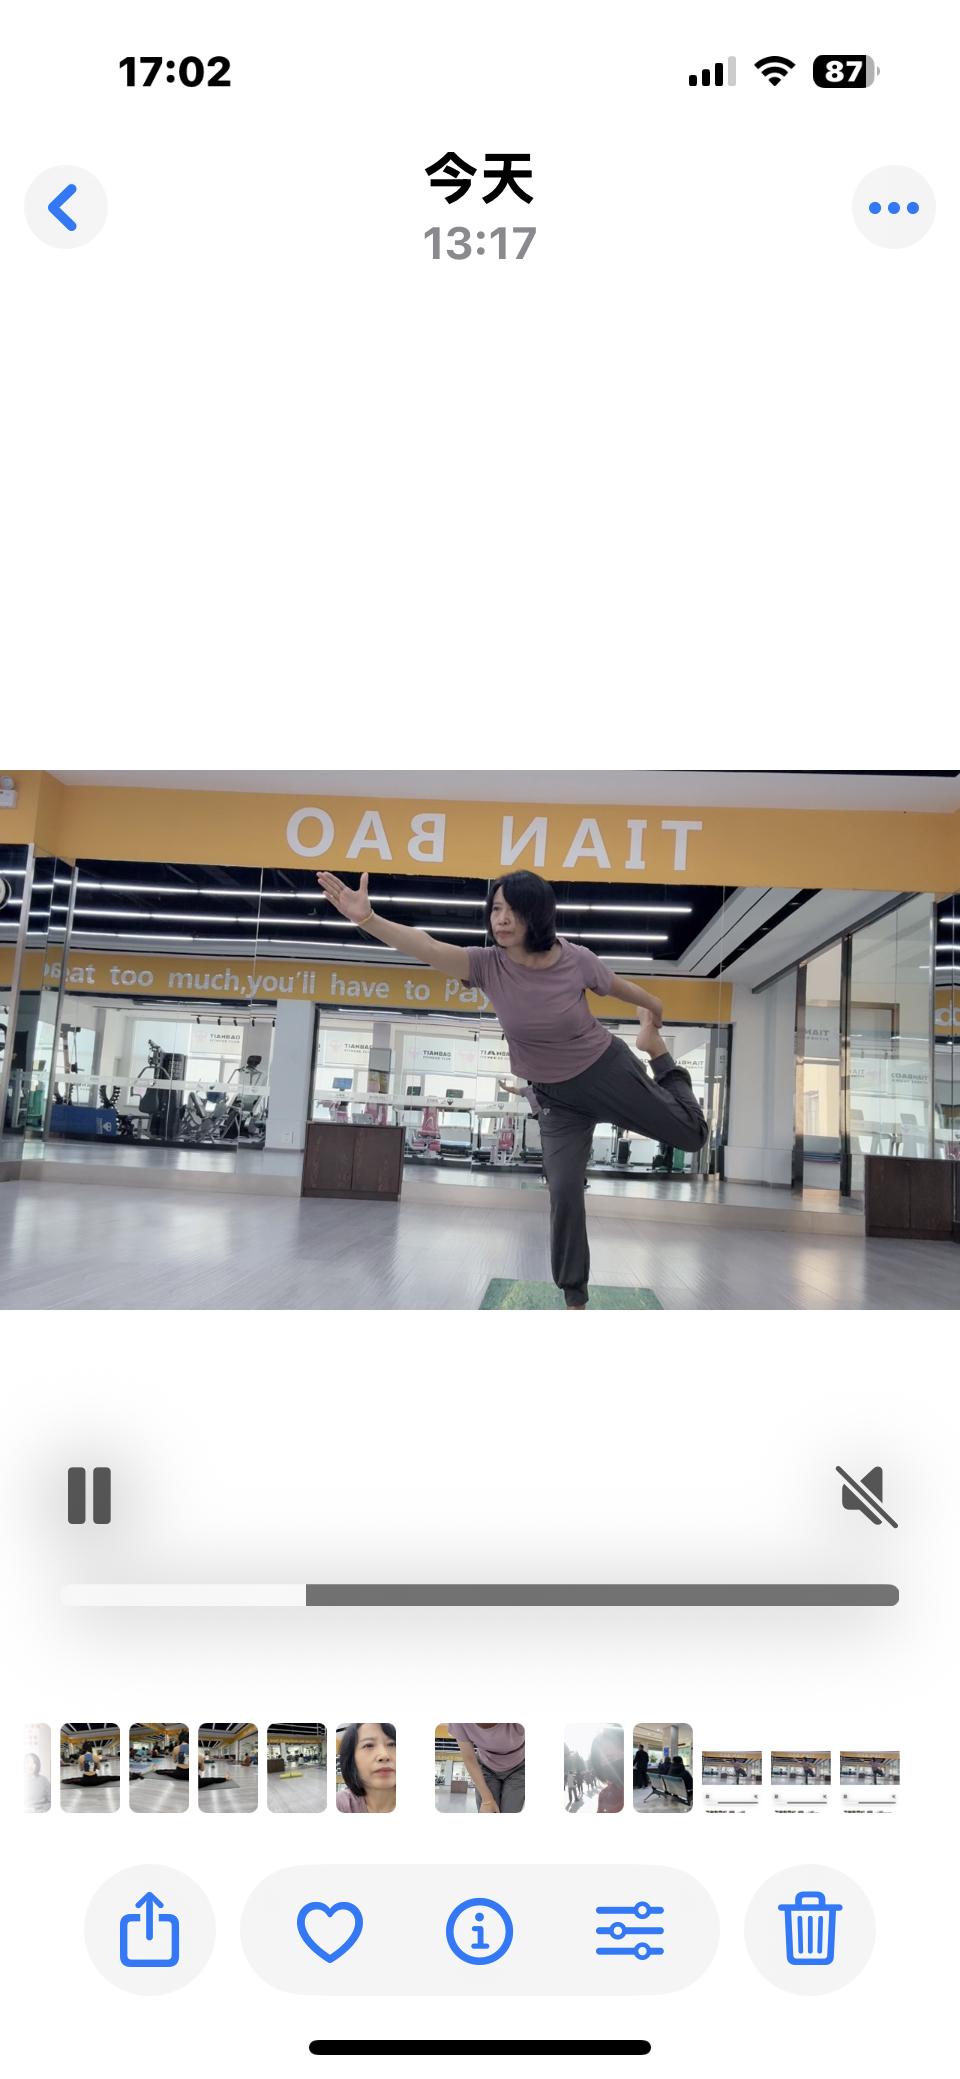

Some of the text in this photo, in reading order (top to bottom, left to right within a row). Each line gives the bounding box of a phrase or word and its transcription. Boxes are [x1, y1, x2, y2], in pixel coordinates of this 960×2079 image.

[119, 56, 232, 87] 17:02
[825, 61, 863, 83] 87
[425, 151, 534, 205] 今天
[424, 226, 537, 261] 13:17
[110, 966, 154, 987] too
[331, 972, 390, 998] have
[404, 980, 430, 1001] to
